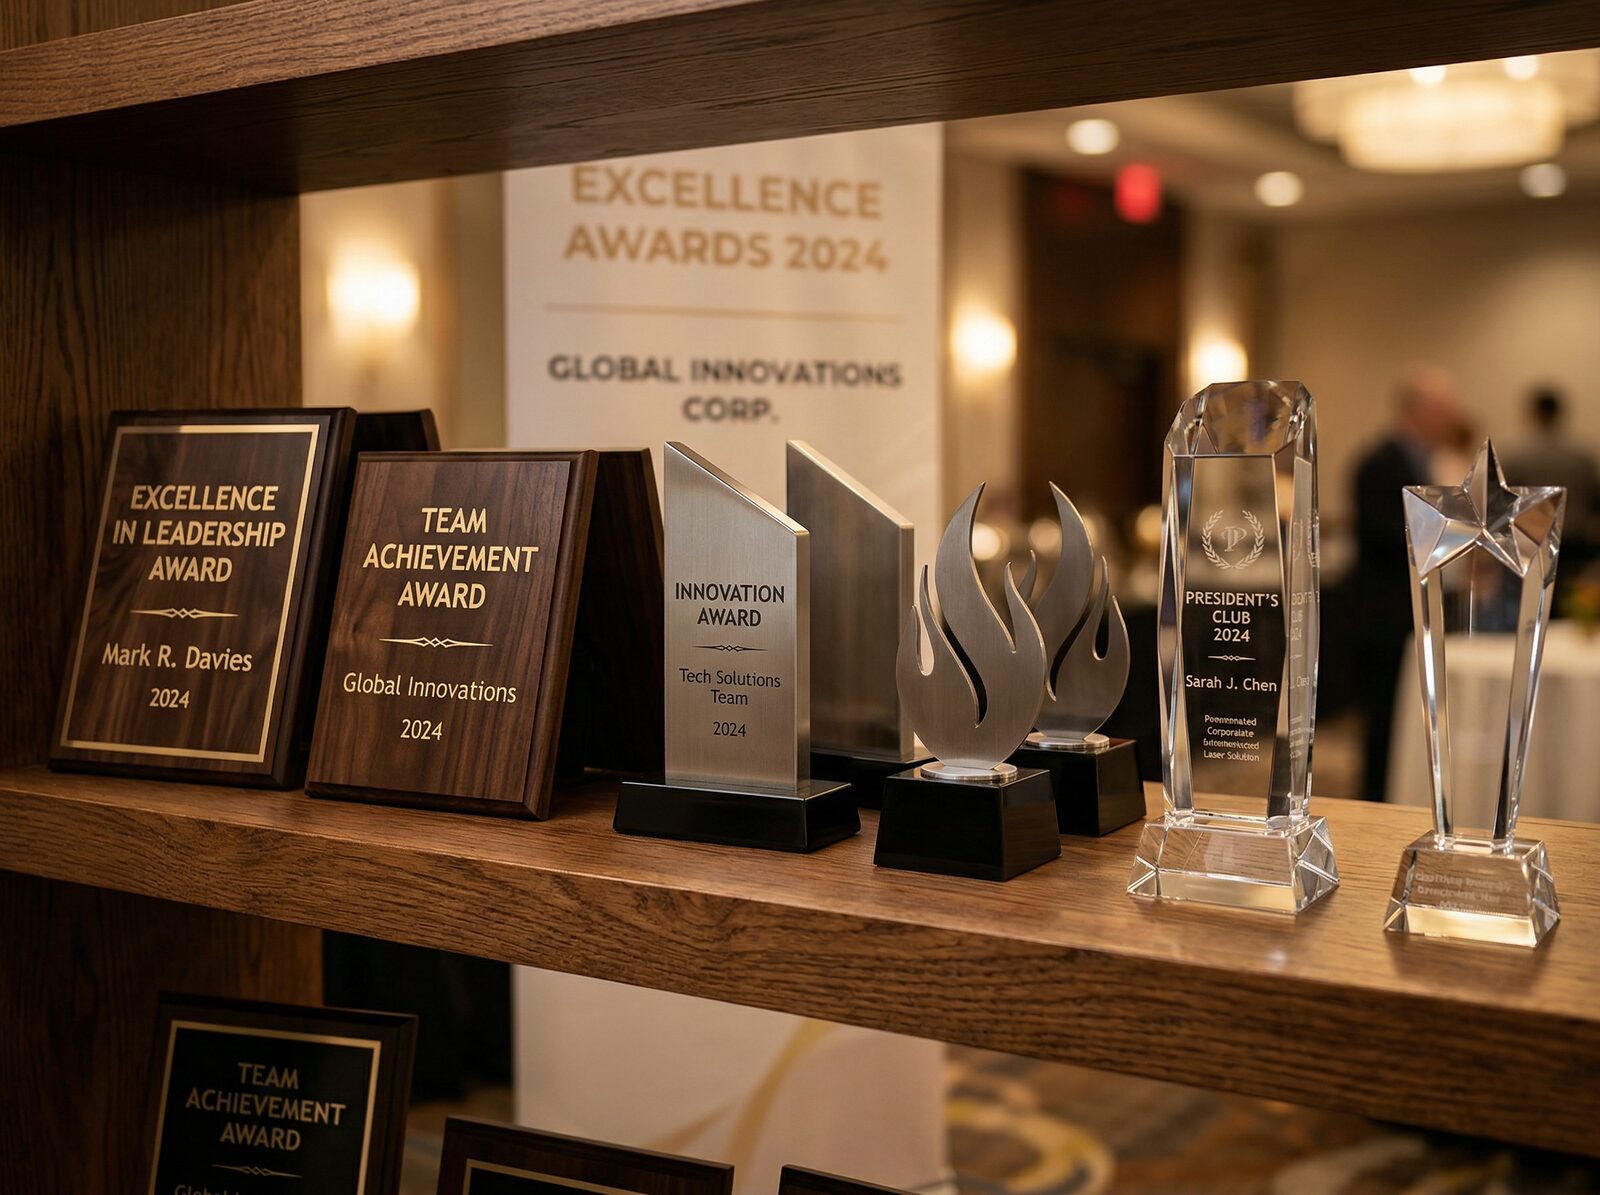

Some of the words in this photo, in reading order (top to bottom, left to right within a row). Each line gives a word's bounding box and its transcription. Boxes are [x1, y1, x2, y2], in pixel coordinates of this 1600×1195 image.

[571, 164, 883, 220] EXCELLENCE
[563, 225, 772, 269] AWARDS
[785, 236, 890, 273] 2024
[547, 355, 680, 383] GLOBAL
[690, 359, 903, 388] INNOVATIONS
[682, 397, 779, 424] CORP.
[130, 485, 279, 511] EXCELLENCE
[112, 520, 137, 544] IN
[142, 520, 286, 547] LEADERSHIP
[421, 507, 487, 534] TEAM
[148, 556, 233, 582] AWARD
[363, 543, 539, 573] ACHIEVEMENT
[397, 581, 486, 609] AWARD
[675, 582, 785, 603] INNOVATION
[1186, 591, 1279, 607] PRESIDENT'S
[697, 607, 762, 627] AWARD
[1212, 610, 1251, 624] CLUB
[1213, 627, 1250, 642] 2024
[101, 643, 151, 667] Mark
[156, 645, 177, 668] R.
[185, 646, 253, 672] Davies
[343, 672, 402, 696] Global
[407, 676, 517, 703] Innovations
[679, 668, 712, 684] Tech
[716, 670, 781, 688] Solutions
[1185, 675, 1222, 689] Sarah
[1226, 677, 1238, 690] J.
[1243, 678, 1278, 692] Chen
[149, 688, 190, 709] 2024
[710, 689, 748, 705] Team
[400, 719, 443, 741] 2024
[713, 721, 747, 737] 2024
[1203, 750, 1226, 759] Laser
[1226, 751, 1260, 762] Solution
[238, 1062, 299, 1089] TEAM
[185, 1088, 346, 1126] ACHIEVEMENT
[220, 1122, 301, 1151] AWARD
